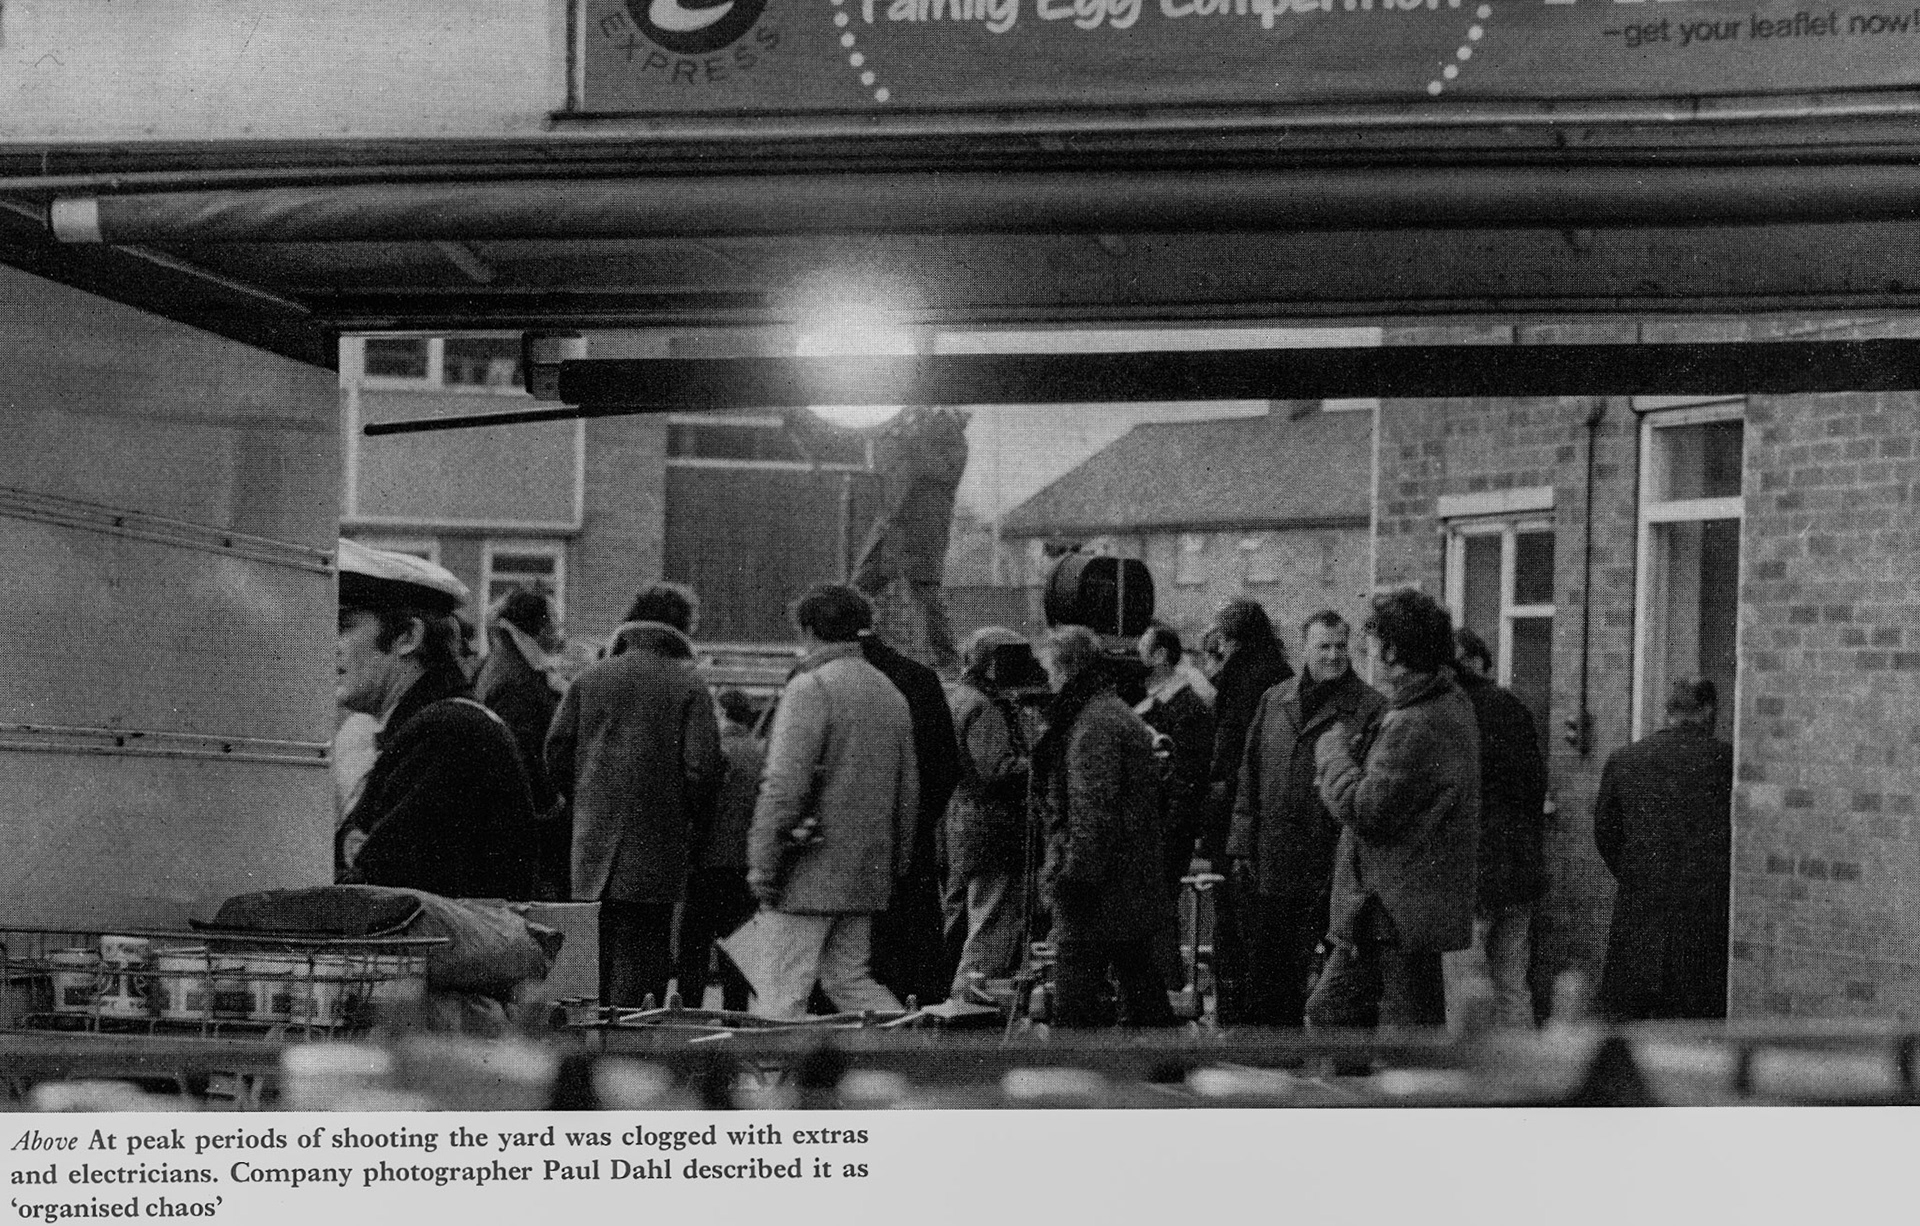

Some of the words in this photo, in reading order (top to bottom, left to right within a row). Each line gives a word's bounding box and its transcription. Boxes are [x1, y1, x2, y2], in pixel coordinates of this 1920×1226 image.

[600, 11, 780, 86] EXPRESS
[1679, 19, 1741, 48] your
[1750, 10, 1840, 40] leaflet
